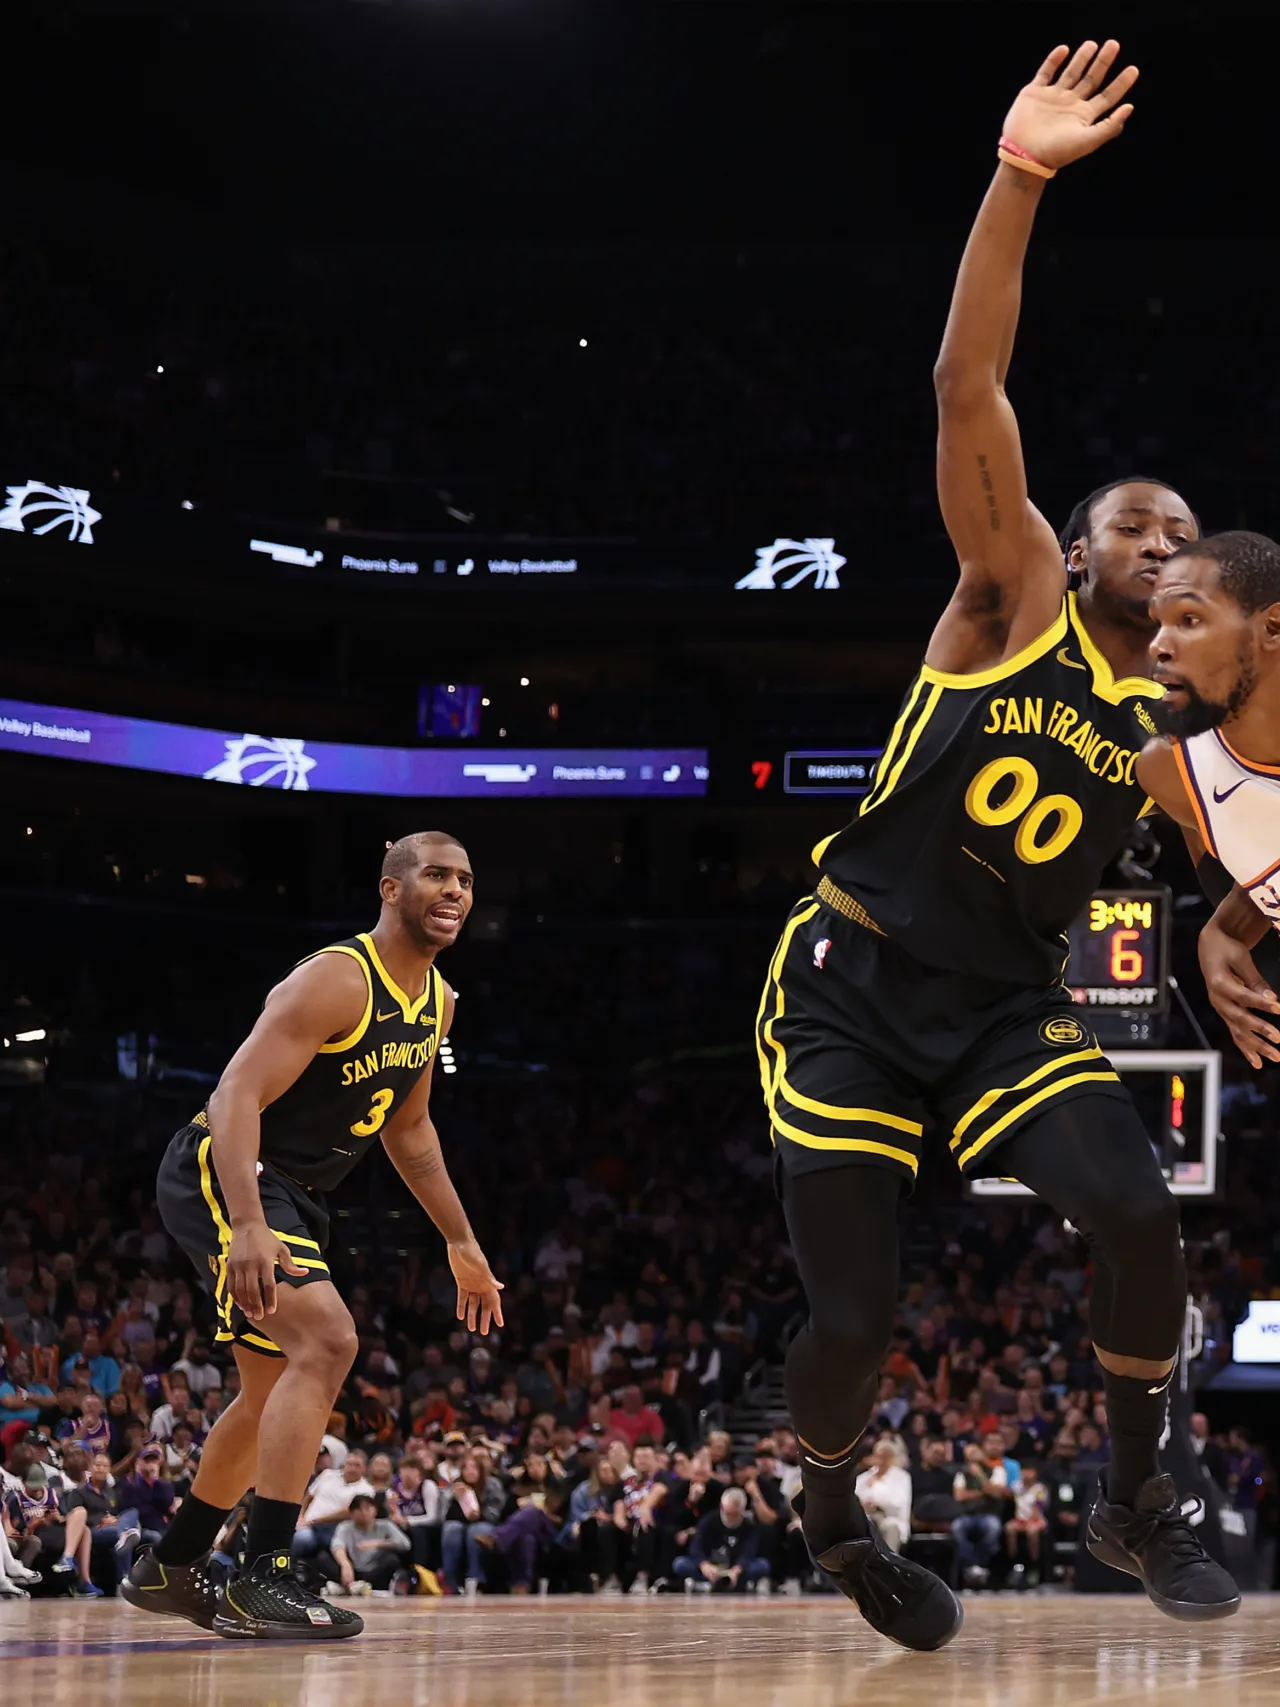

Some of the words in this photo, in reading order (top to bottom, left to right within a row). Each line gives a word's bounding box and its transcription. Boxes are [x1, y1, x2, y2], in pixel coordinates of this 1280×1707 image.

[32, 721, 92, 743] Basketball
[984, 697, 1043, 735] SAN
[1046, 700, 1141, 786] FRANCISC
[751, 761, 773, 790] 7
[965, 756, 1083, 865] 00
[1089, 900, 1152, 931] 3:44
[1110, 930, 1143, 982] 6
[1085, 987, 1158, 1005] TISSOT
[341, 1050, 380, 1086] SAN
[381, 1033, 435, 1070] FRANCISCO
[350, 1088, 395, 1138] 3
